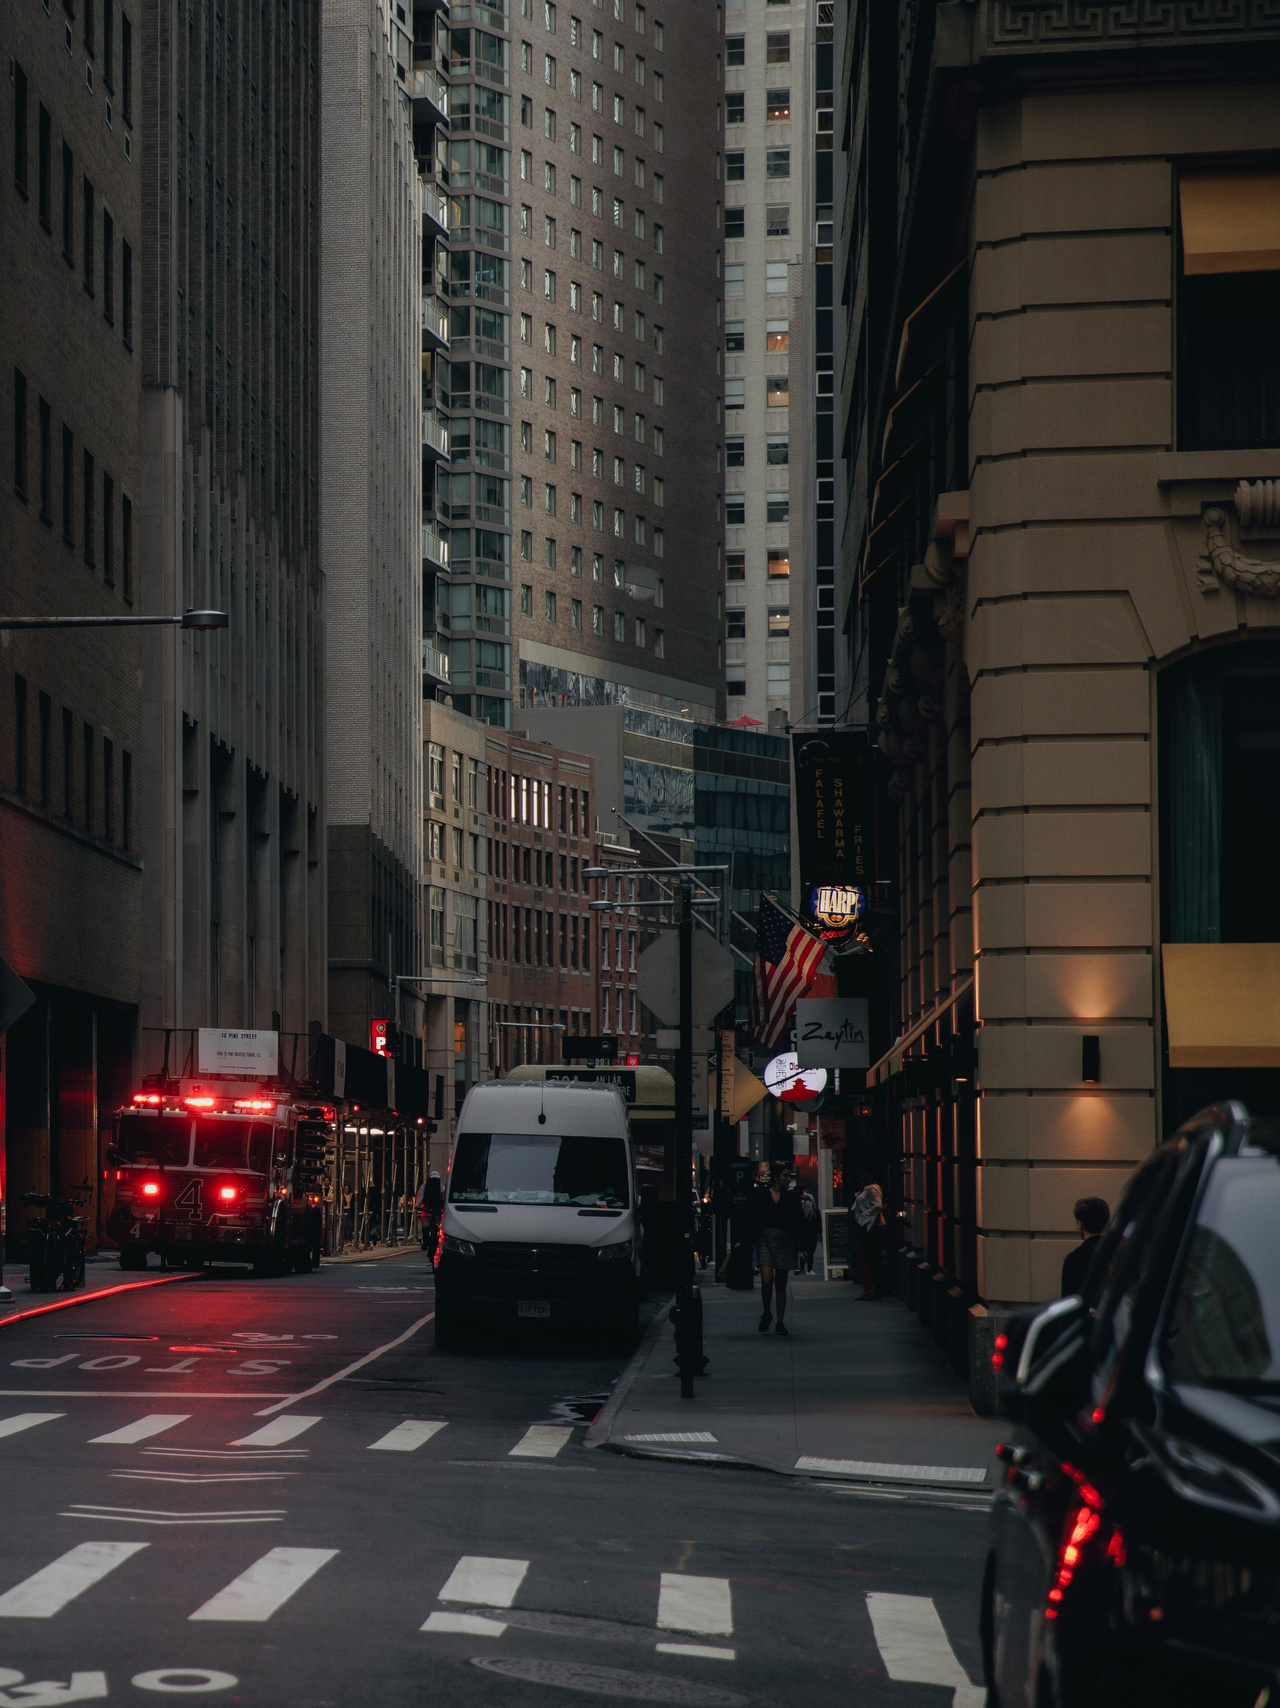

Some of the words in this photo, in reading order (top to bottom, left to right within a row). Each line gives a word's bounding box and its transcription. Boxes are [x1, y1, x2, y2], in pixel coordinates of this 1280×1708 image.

[815, 769, 825, 839] FALAFEL
[833, 778, 845, 858] SHAWARMA
[854, 825, 864, 875] FRIES
[820, 889, 856, 913] HARP
[801, 1018, 864, 1050] Zeytin
[595, 1075, 605, 1083] AN
[174, 1179, 203, 1220] 4
[130, 1222, 141, 1238] 4
[9, 1353, 292, 1376] STOP
